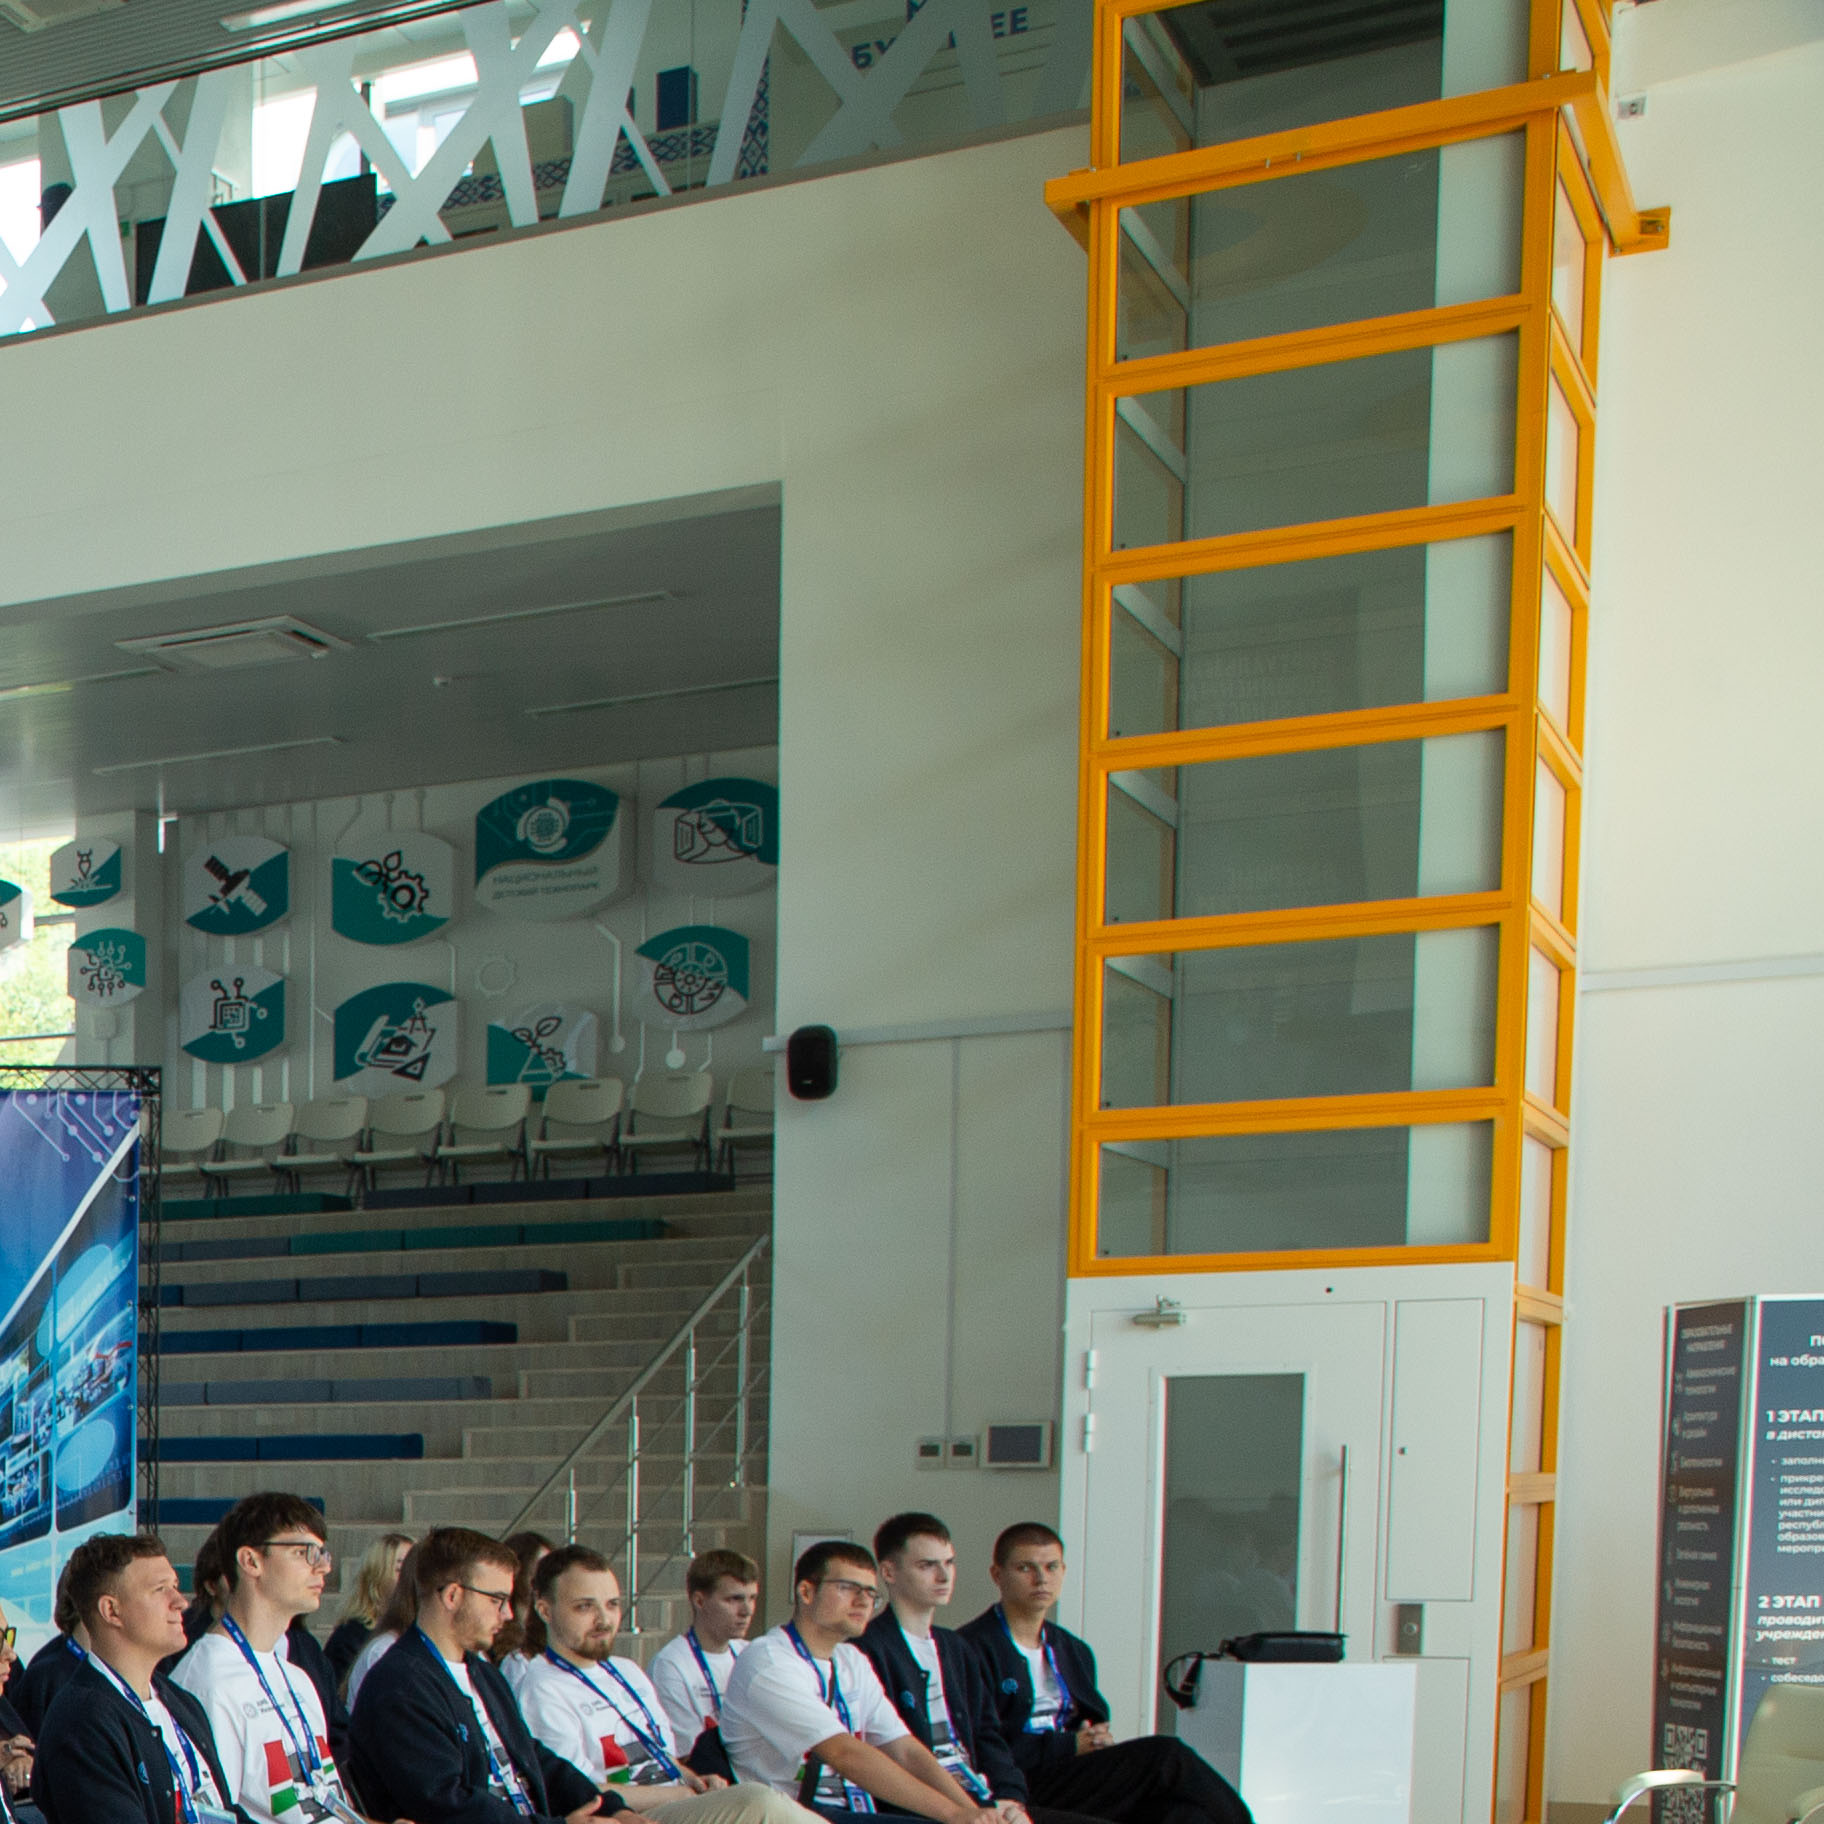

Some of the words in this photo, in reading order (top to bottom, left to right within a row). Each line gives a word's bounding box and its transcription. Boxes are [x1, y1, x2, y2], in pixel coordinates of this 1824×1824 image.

[1770, 1356, 1789, 1367] на
[1766, 1409, 1775, 1423] 1
[1777, 1409, 1824, 1423] ЭТАП
[1758, 1594, 1770, 1609] 2
[1772, 1594, 1820, 1609] ЭТАП
